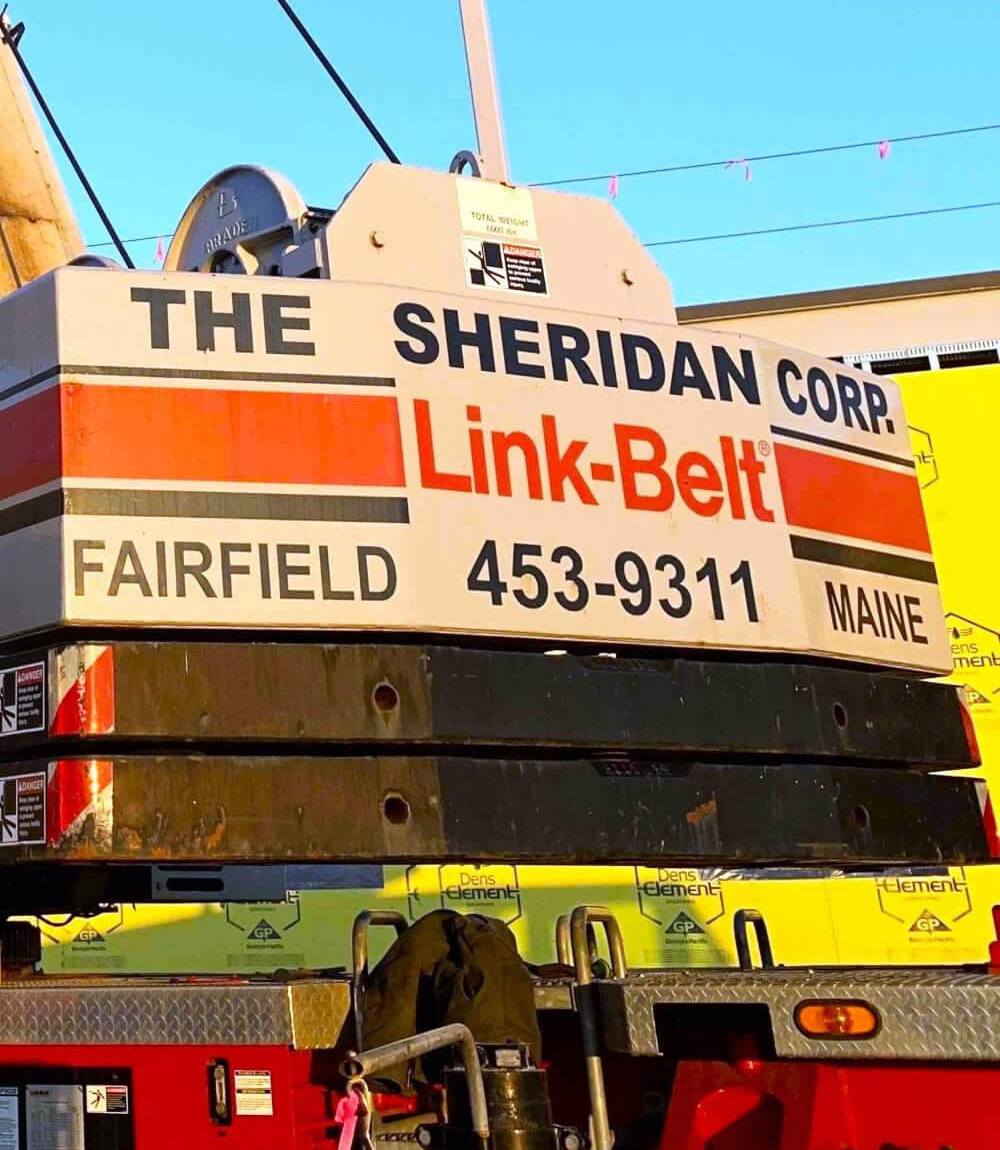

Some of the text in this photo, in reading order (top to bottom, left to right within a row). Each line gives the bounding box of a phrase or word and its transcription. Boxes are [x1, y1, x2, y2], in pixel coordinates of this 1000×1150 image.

[130, 287, 896, 435] THE SHERIDAN CORP.
[413, 398, 775, 523] Link-Belt
[73, 539, 929, 645] FAIRFIELD 453-9311 MAINE
[951, 642, 979, 655] ens
[952, 651, 1000, 668] ment
[460, 872, 496, 886] Dens
[658, 867, 697, 882] Dens
[445, 884, 518, 900] Element
[642, 881, 719, 897] Element
[672, 921, 695, 933] GP
[915, 917, 941, 931] GP
[79, 930, 97, 941] GP
[254, 927, 273, 939] GP
